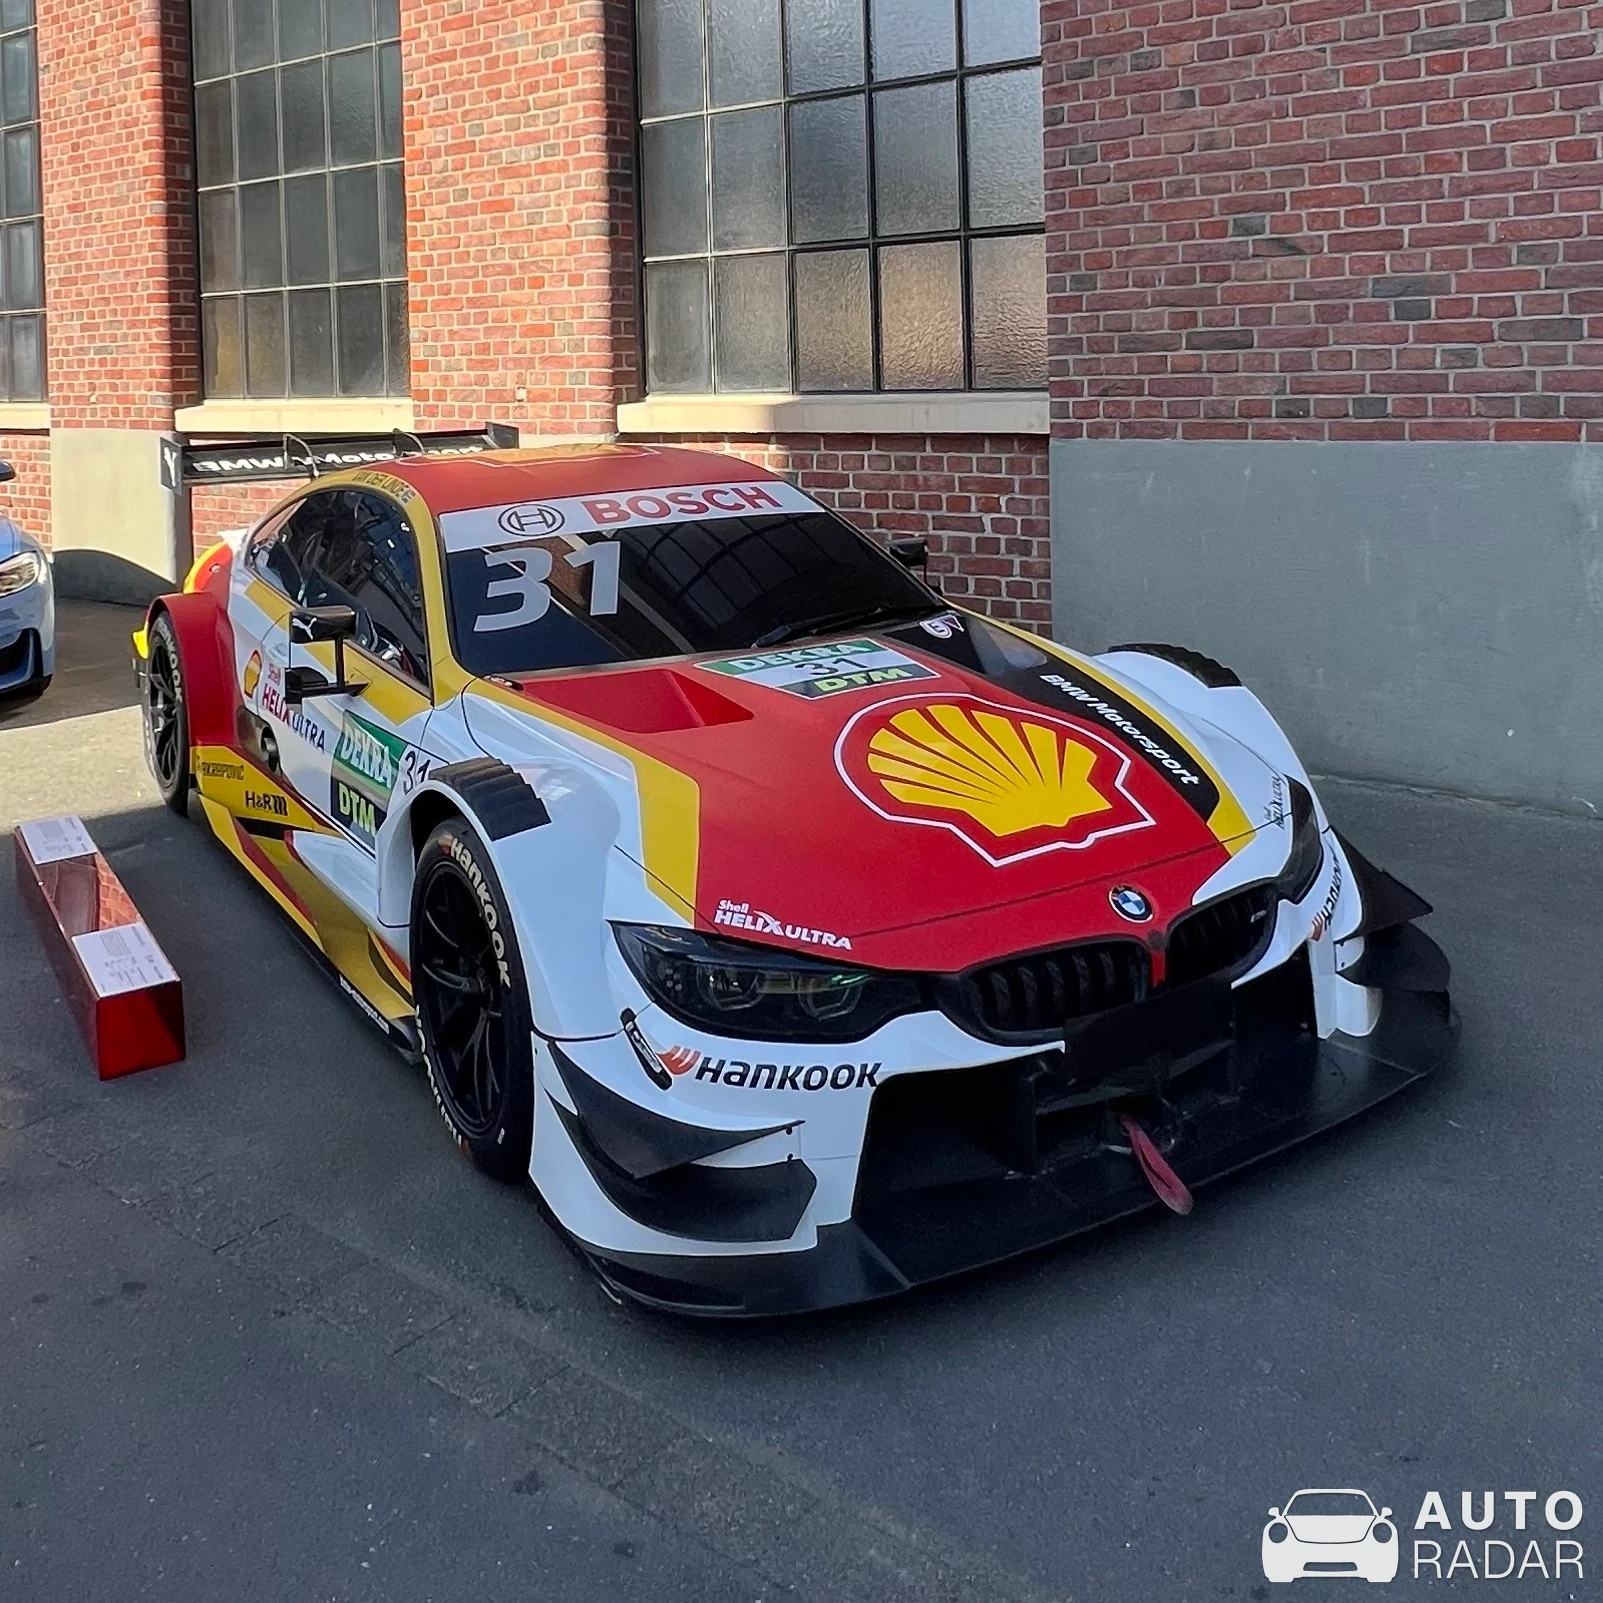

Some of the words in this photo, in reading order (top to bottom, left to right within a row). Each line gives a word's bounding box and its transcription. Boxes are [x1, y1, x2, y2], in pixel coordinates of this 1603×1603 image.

[192, 456, 284, 472] BMW
[581, 486, 783, 526] BOSCH
[473, 540, 621, 633] 31
[729, 642, 872, 671] DEKRA
[795, 657, 868, 676] 31
[813, 668, 913, 692] DTM
[1039, 674, 1100, 702] BMW
[1087, 702, 1199, 785] Motorsport
[339, 718, 393, 788] DEKRA
[403, 750, 431, 796] 31
[338, 782, 377, 837] DTM
[719, 899, 749, 913] Shell
[714, 909, 785, 936] HELIX
[785, 924, 852, 950] ULTRA
